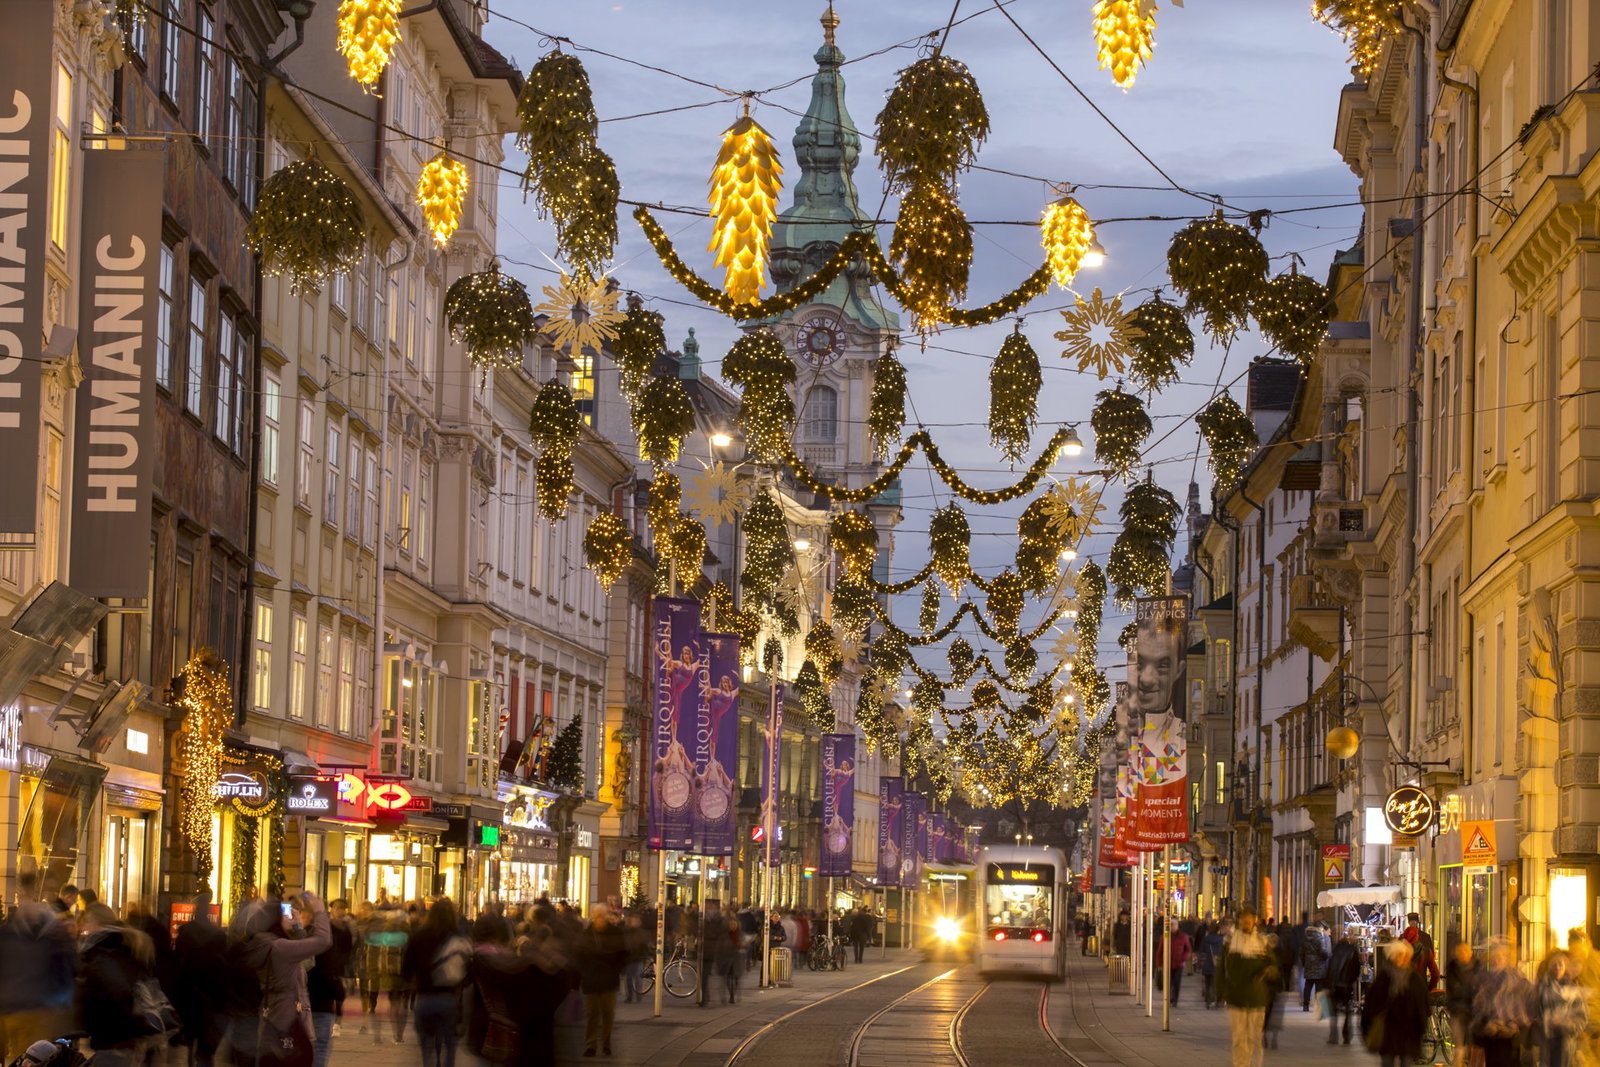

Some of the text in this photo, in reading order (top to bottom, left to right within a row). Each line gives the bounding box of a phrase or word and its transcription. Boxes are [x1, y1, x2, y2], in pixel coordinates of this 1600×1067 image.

[87, 234, 146, 512] HUMANIC
[1137, 609, 1186, 620] OLYMPICS
[1139, 599, 1185, 610] SPECIAL
[657, 677, 674, 760] CIRQUE
[695, 703, 713, 777] CIRQUE
[288, 797, 329, 809] ROLEX
[825, 778, 836, 827] CIRQUE
